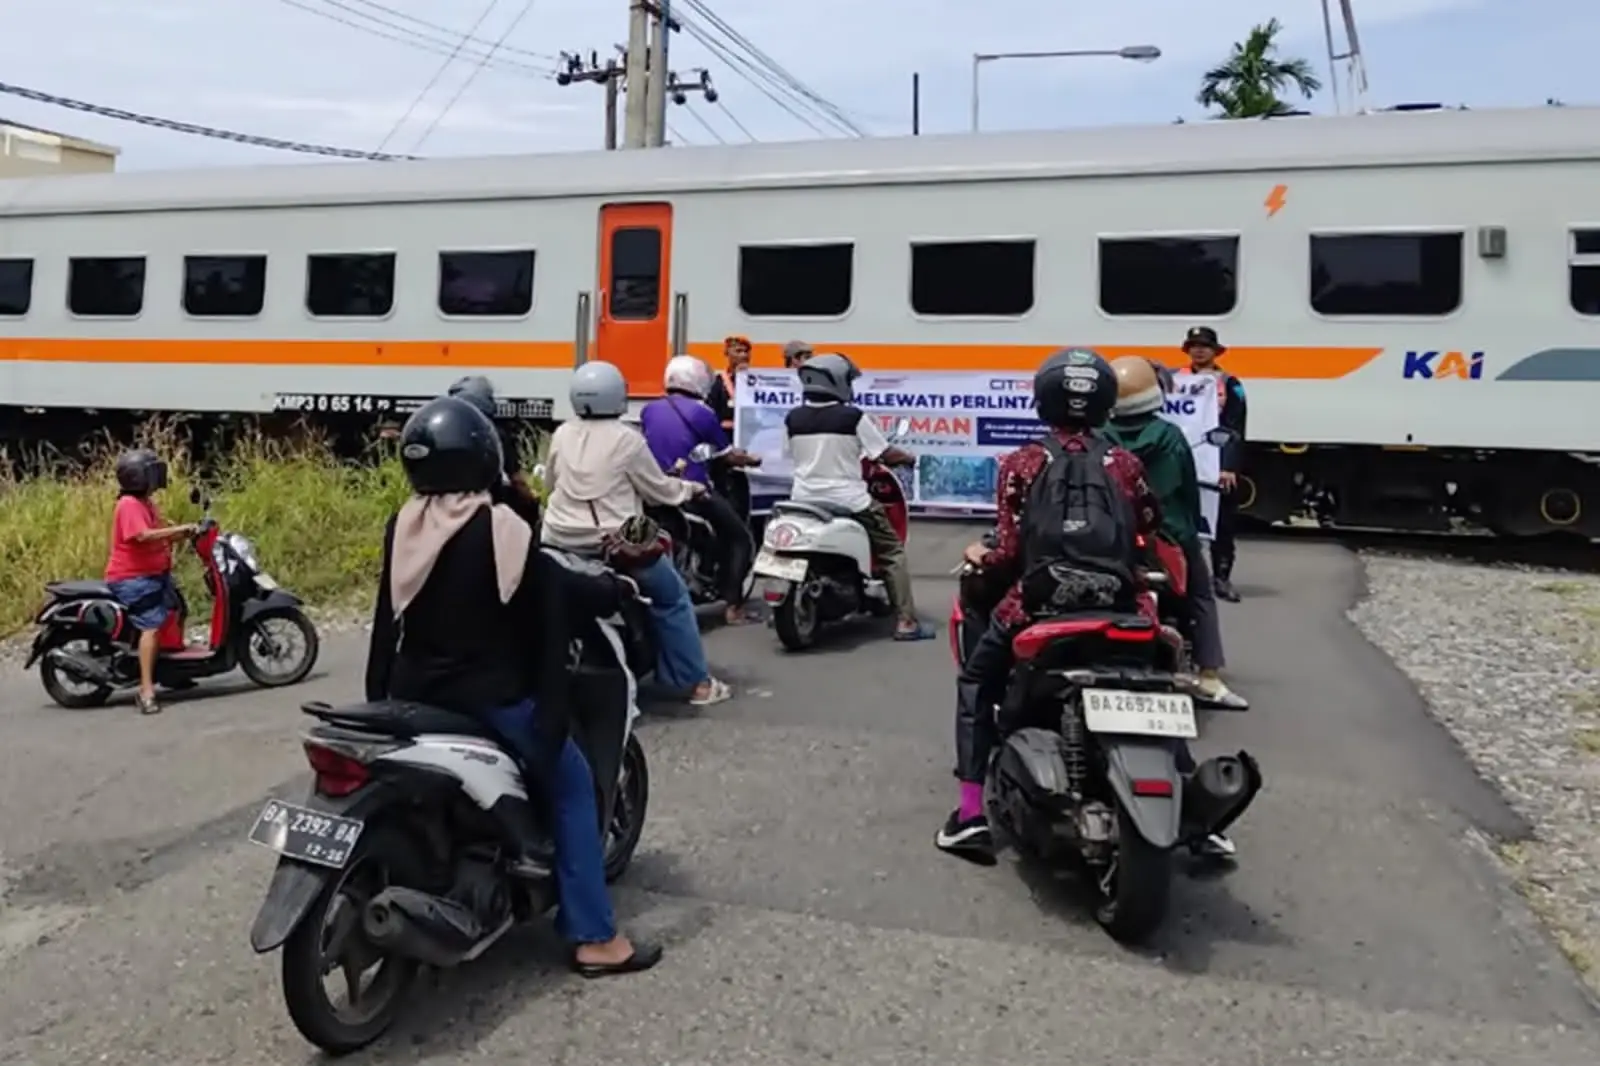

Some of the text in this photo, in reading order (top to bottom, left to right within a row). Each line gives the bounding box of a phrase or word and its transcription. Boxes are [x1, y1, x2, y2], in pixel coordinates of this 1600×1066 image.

[1403, 351, 1485, 380] KAI
[317, 395, 327, 411] 0
[330, 396, 350, 411] 65
[354, 396, 372, 412] 14
[754, 391, 800, 404] HATI-
[853, 393, 945, 408] MELEWATI
[950, 395, 1037, 410] PERLINT
